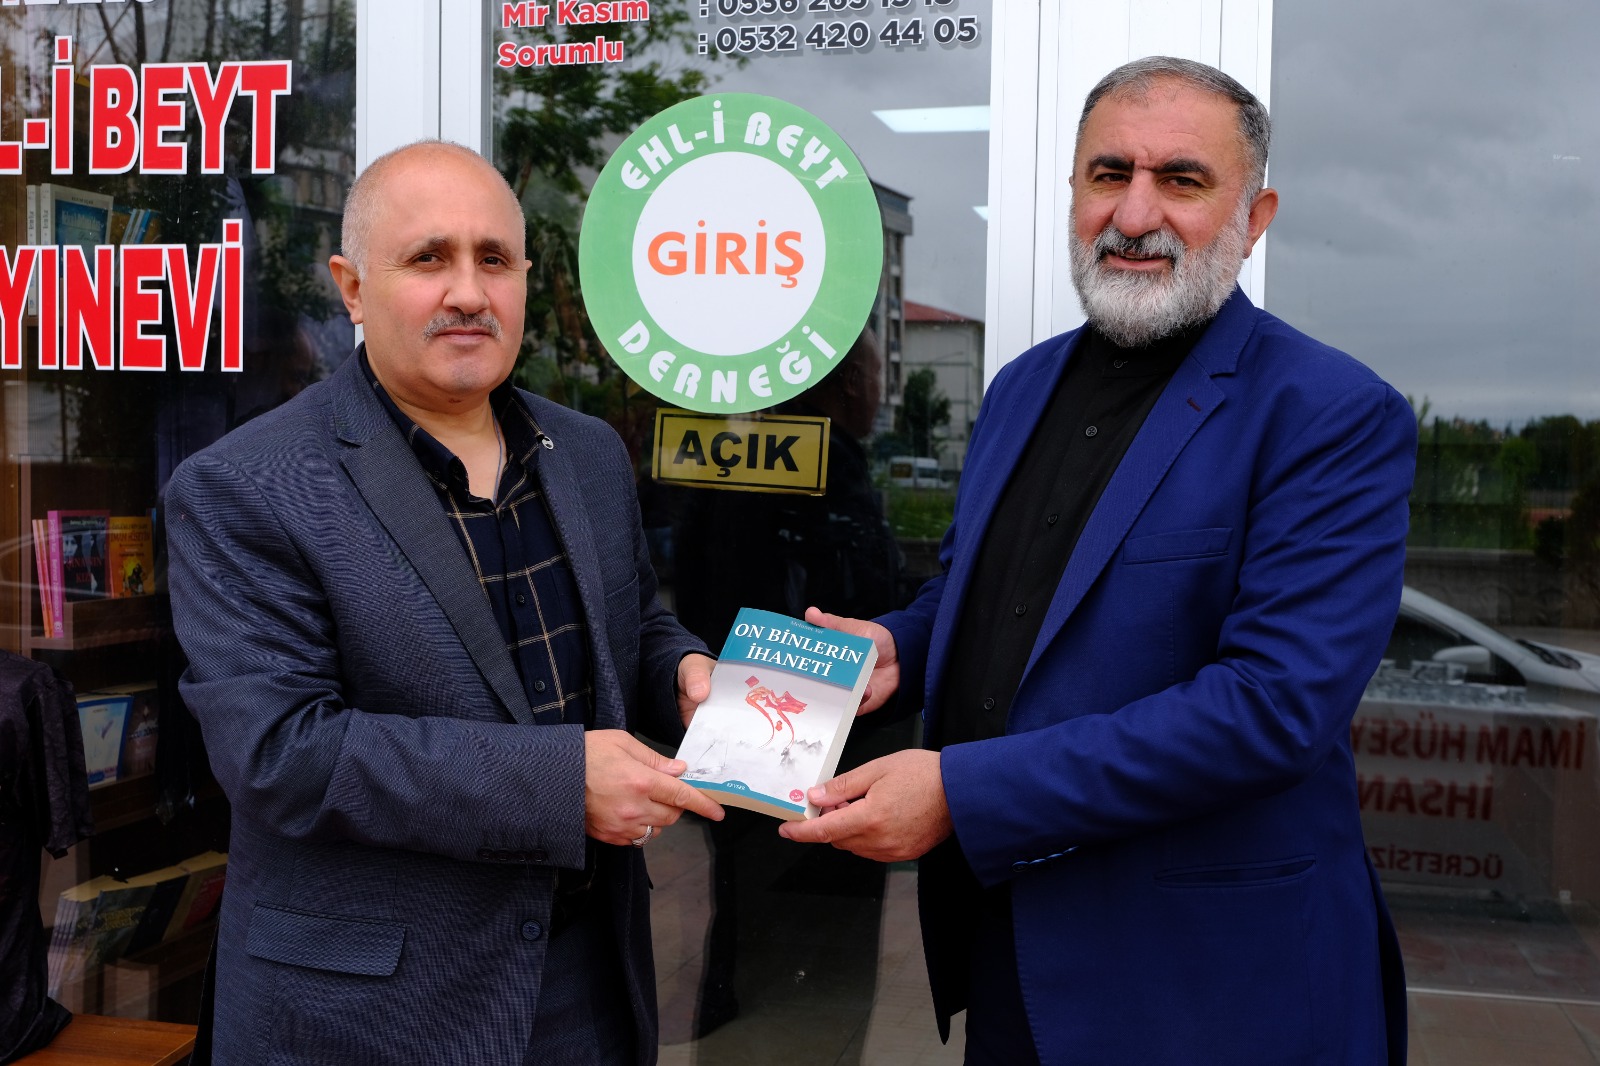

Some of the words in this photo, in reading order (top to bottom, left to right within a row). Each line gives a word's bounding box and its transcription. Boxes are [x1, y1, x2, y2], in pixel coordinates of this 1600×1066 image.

[502, 1, 549, 28] Mir
[557, 0, 649, 25] Kasım
[716, 24, 797, 54] 0532
[805, 20, 871, 49] 420
[879, 17, 924, 45] 44
[933, 15, 979, 43] 05
[497, 36, 624, 67] Sorumlu
[89, 60, 292, 175] BEYT
[620, 100, 725, 190] EHL-İ
[744, 112, 849, 190] BEYT
[647, 219, 804, 288] GİRİŞ
[617, 320, 837, 404] DERNEĞİ
[672, 429, 801, 478] AÇIK
[734, 623, 765, 639] ON
[766, 628, 864, 664] BİNLERİN
[746, 642, 833, 677] İHANETİ
